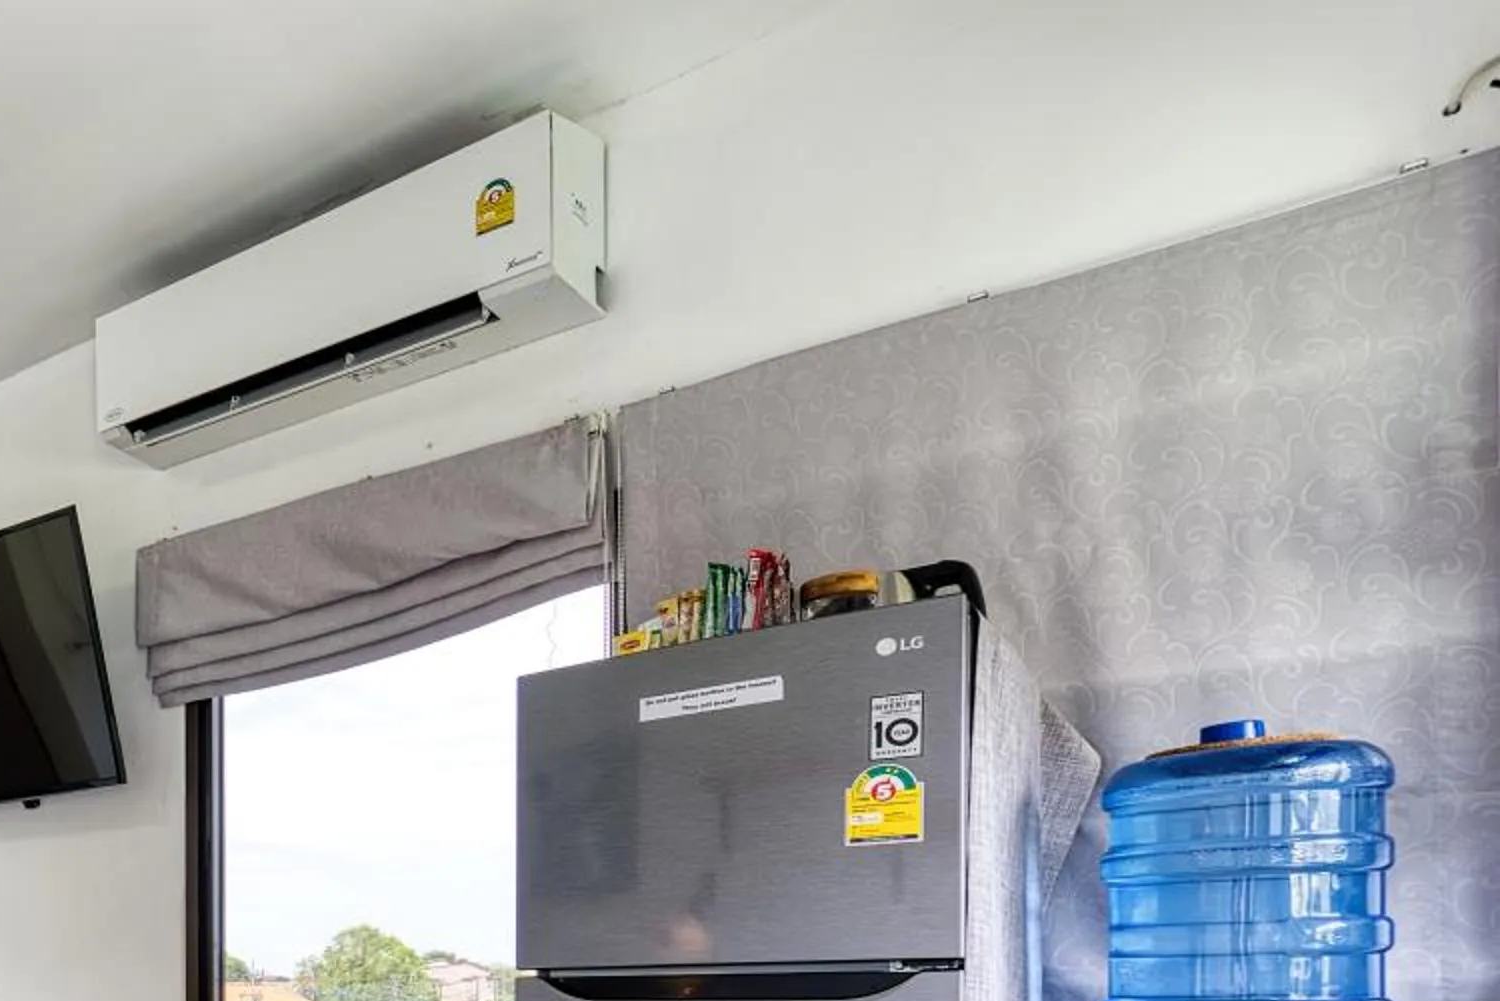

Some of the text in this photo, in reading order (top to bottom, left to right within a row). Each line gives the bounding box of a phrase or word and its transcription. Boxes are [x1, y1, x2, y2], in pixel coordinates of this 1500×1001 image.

[899, 635, 924, 651] LG
[874, 717, 919, 749] 10
[877, 781, 894, 800] 5
